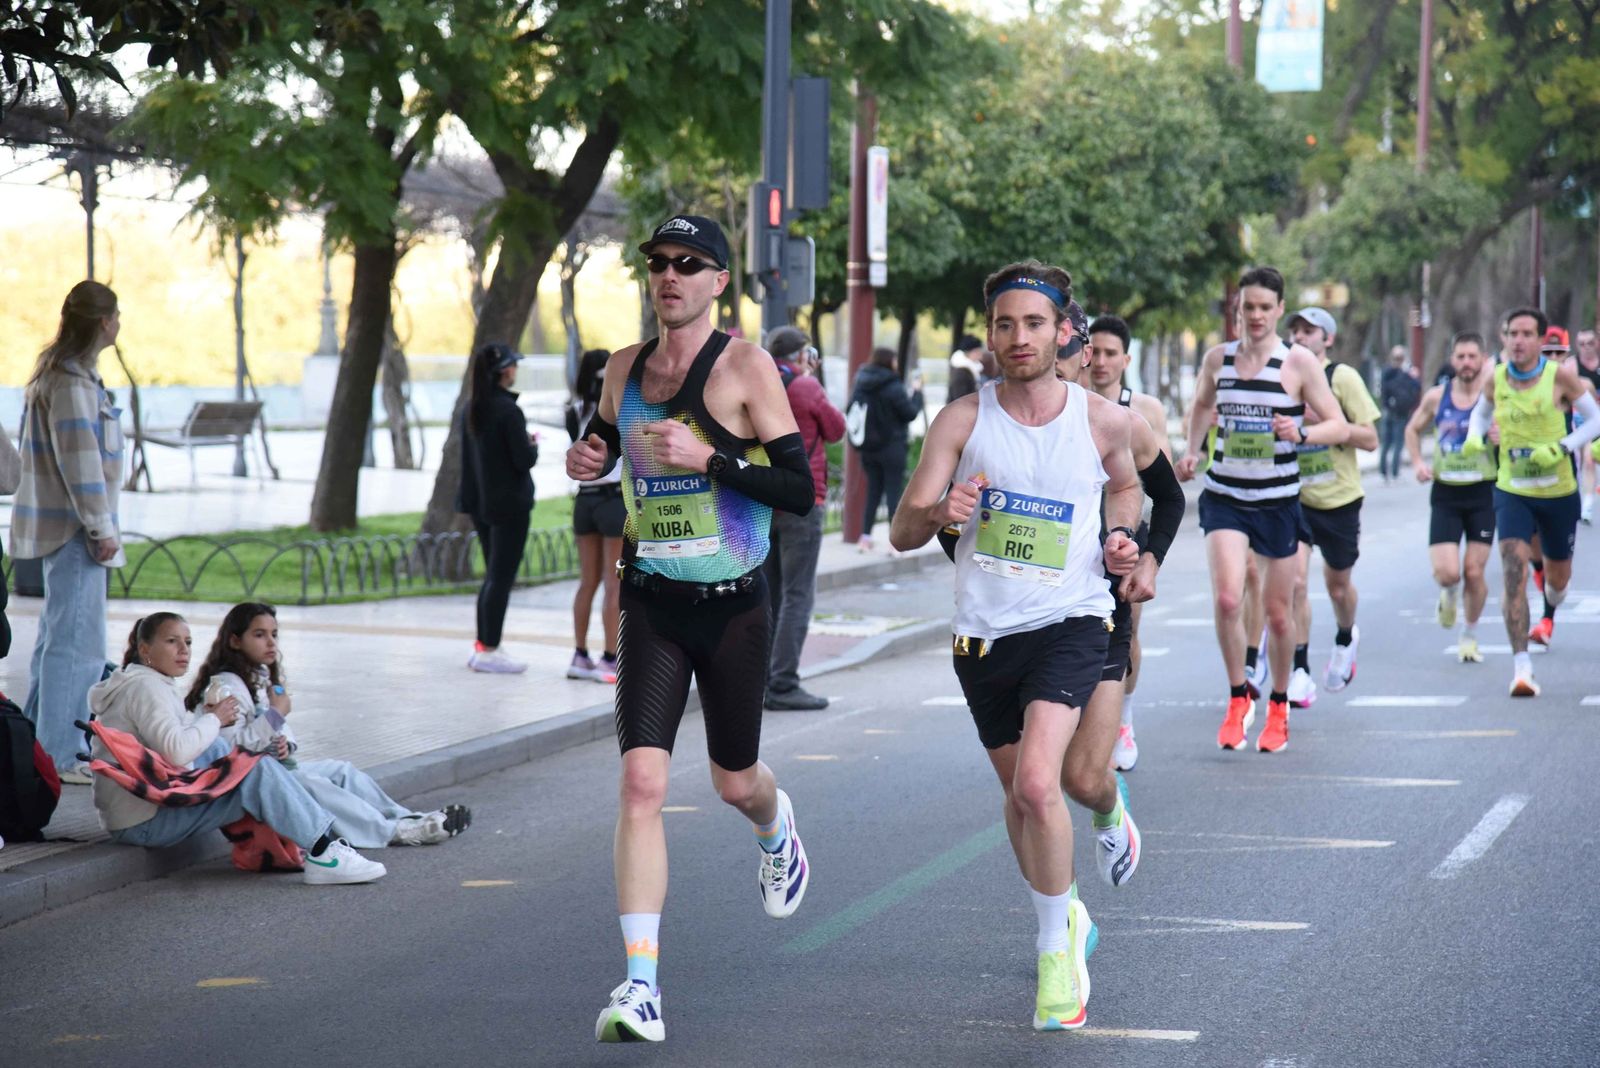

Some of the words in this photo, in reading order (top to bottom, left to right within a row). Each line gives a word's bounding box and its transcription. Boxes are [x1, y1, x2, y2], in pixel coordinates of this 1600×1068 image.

[1221, 404, 1273, 417] HIGHGATE
[1238, 422, 1269, 431] ZURICH
[652, 479, 700, 492] ZURICH
[657, 504, 683, 516] 1506
[1011, 499, 1063, 517] ZURICH
[651, 520, 694, 539] KUBA
[1008, 523, 1037, 538] 2673
[1004, 540, 1034, 560] RIC
